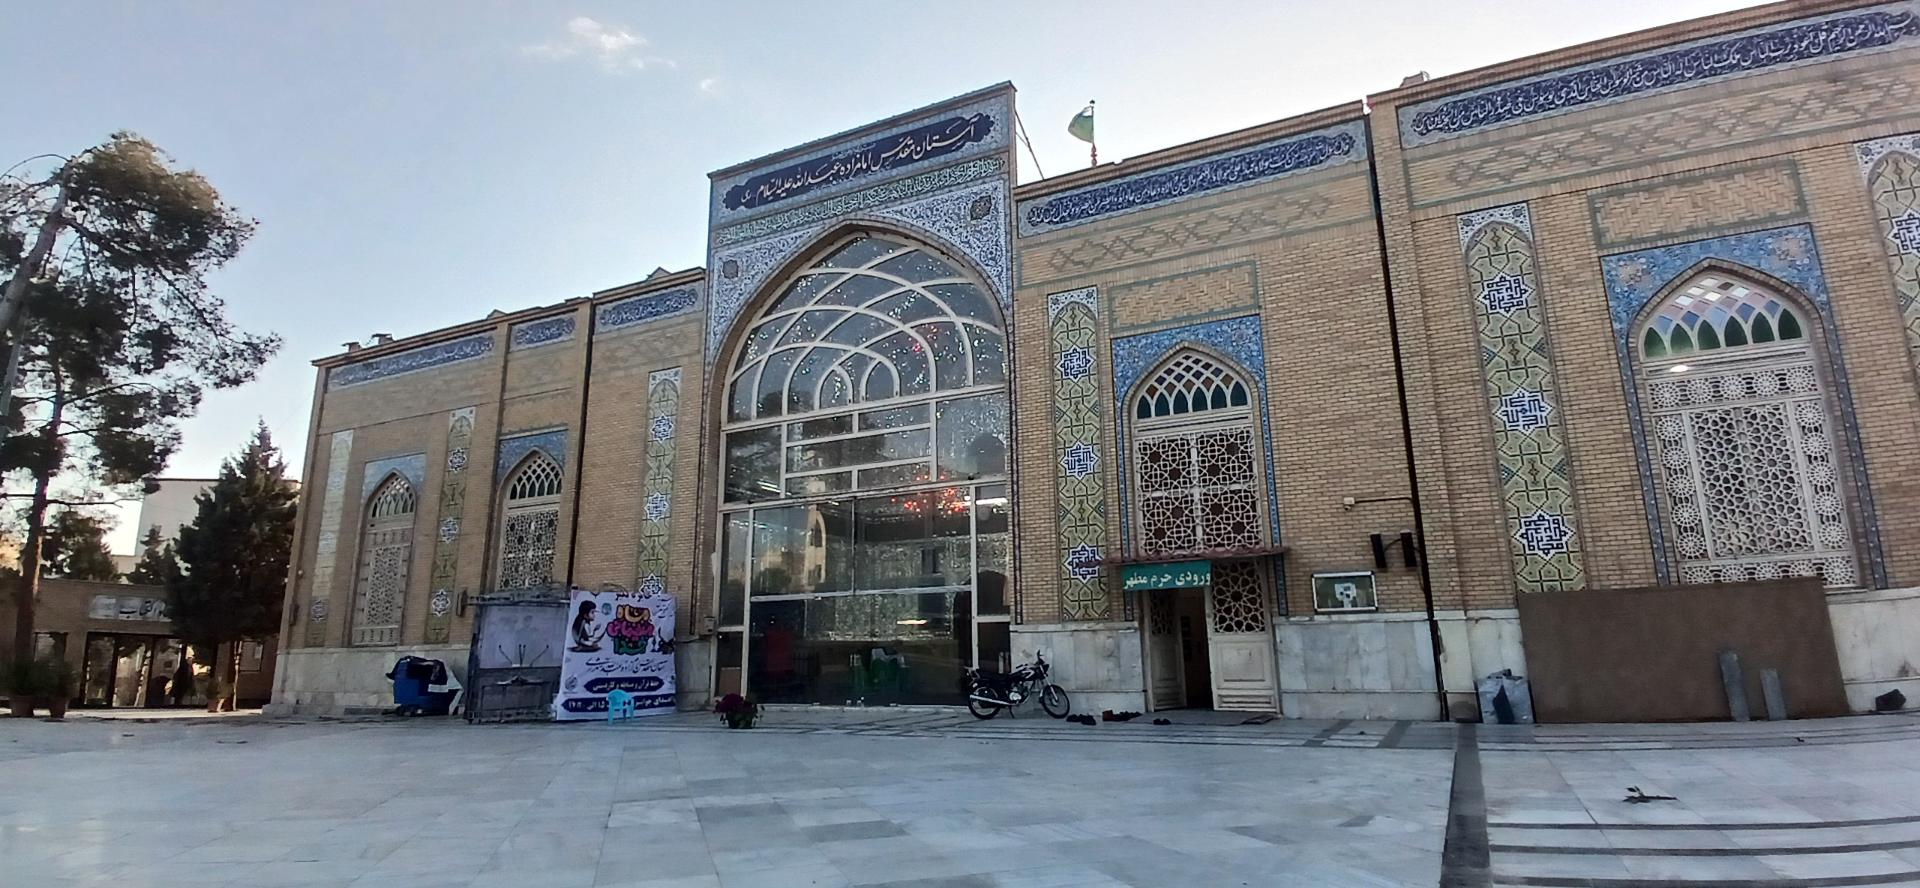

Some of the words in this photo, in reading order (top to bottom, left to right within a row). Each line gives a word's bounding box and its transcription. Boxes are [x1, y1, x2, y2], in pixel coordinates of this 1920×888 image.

[912, 115, 980, 159] آستان
[1123, 571, 1149, 590] مطهر
[1150, 572, 1173, 588] حرم
[1174, 571, 1211, 586] ورودی
